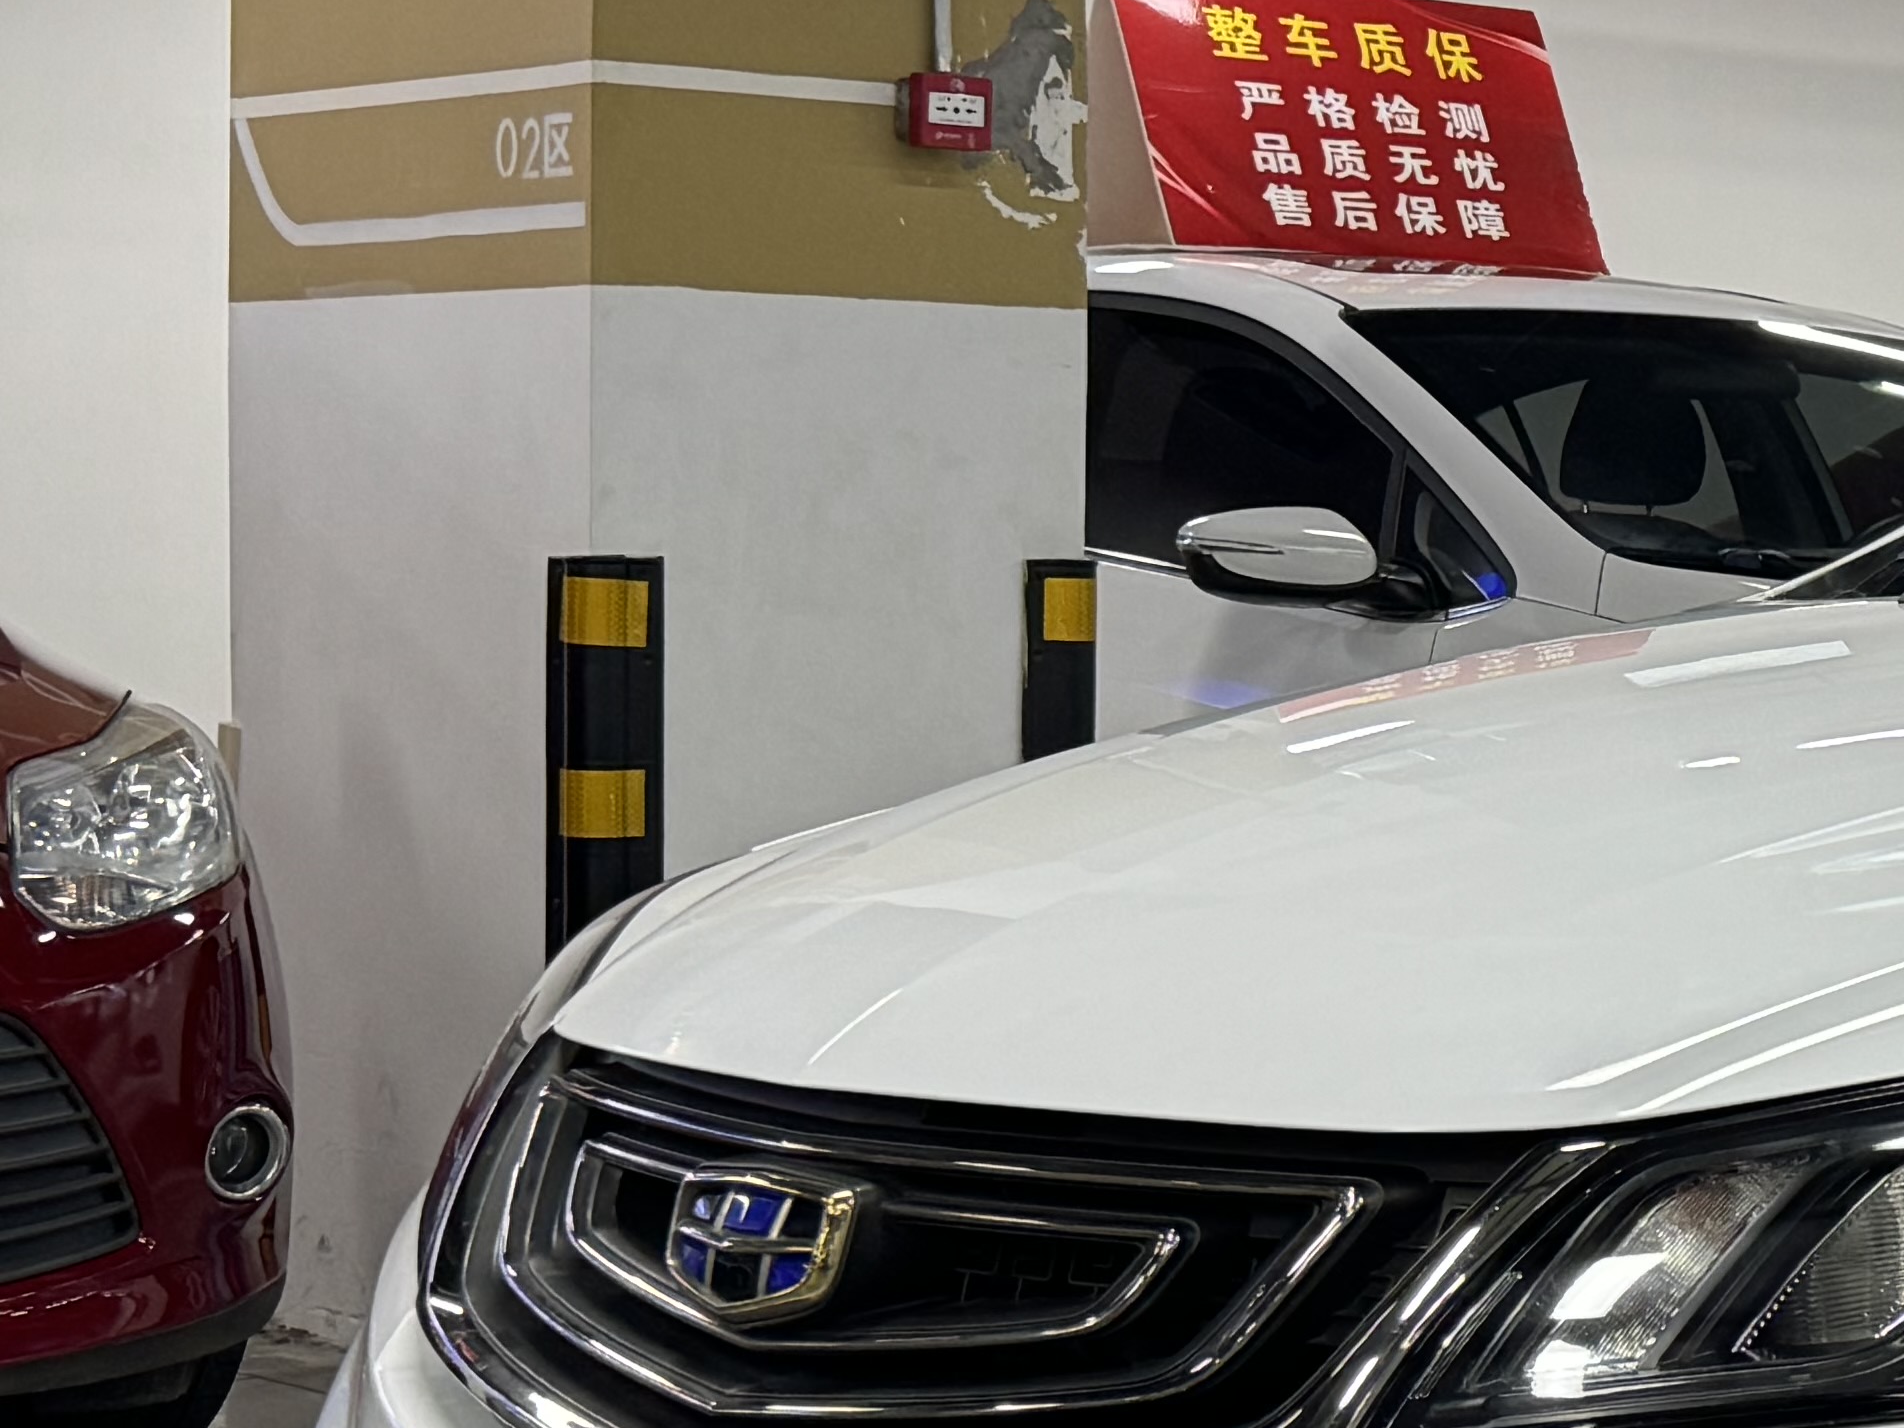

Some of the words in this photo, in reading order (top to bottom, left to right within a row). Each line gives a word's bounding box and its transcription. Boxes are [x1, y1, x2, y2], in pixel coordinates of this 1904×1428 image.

[1201, 4, 1483, 83] 整车质保
[1234, 80, 1490, 143] 严格检测
[496, 112, 573, 178] 02区
[1252, 132, 1505, 192] 品质无忧
[1262, 183, 1510, 241] 售后保障
